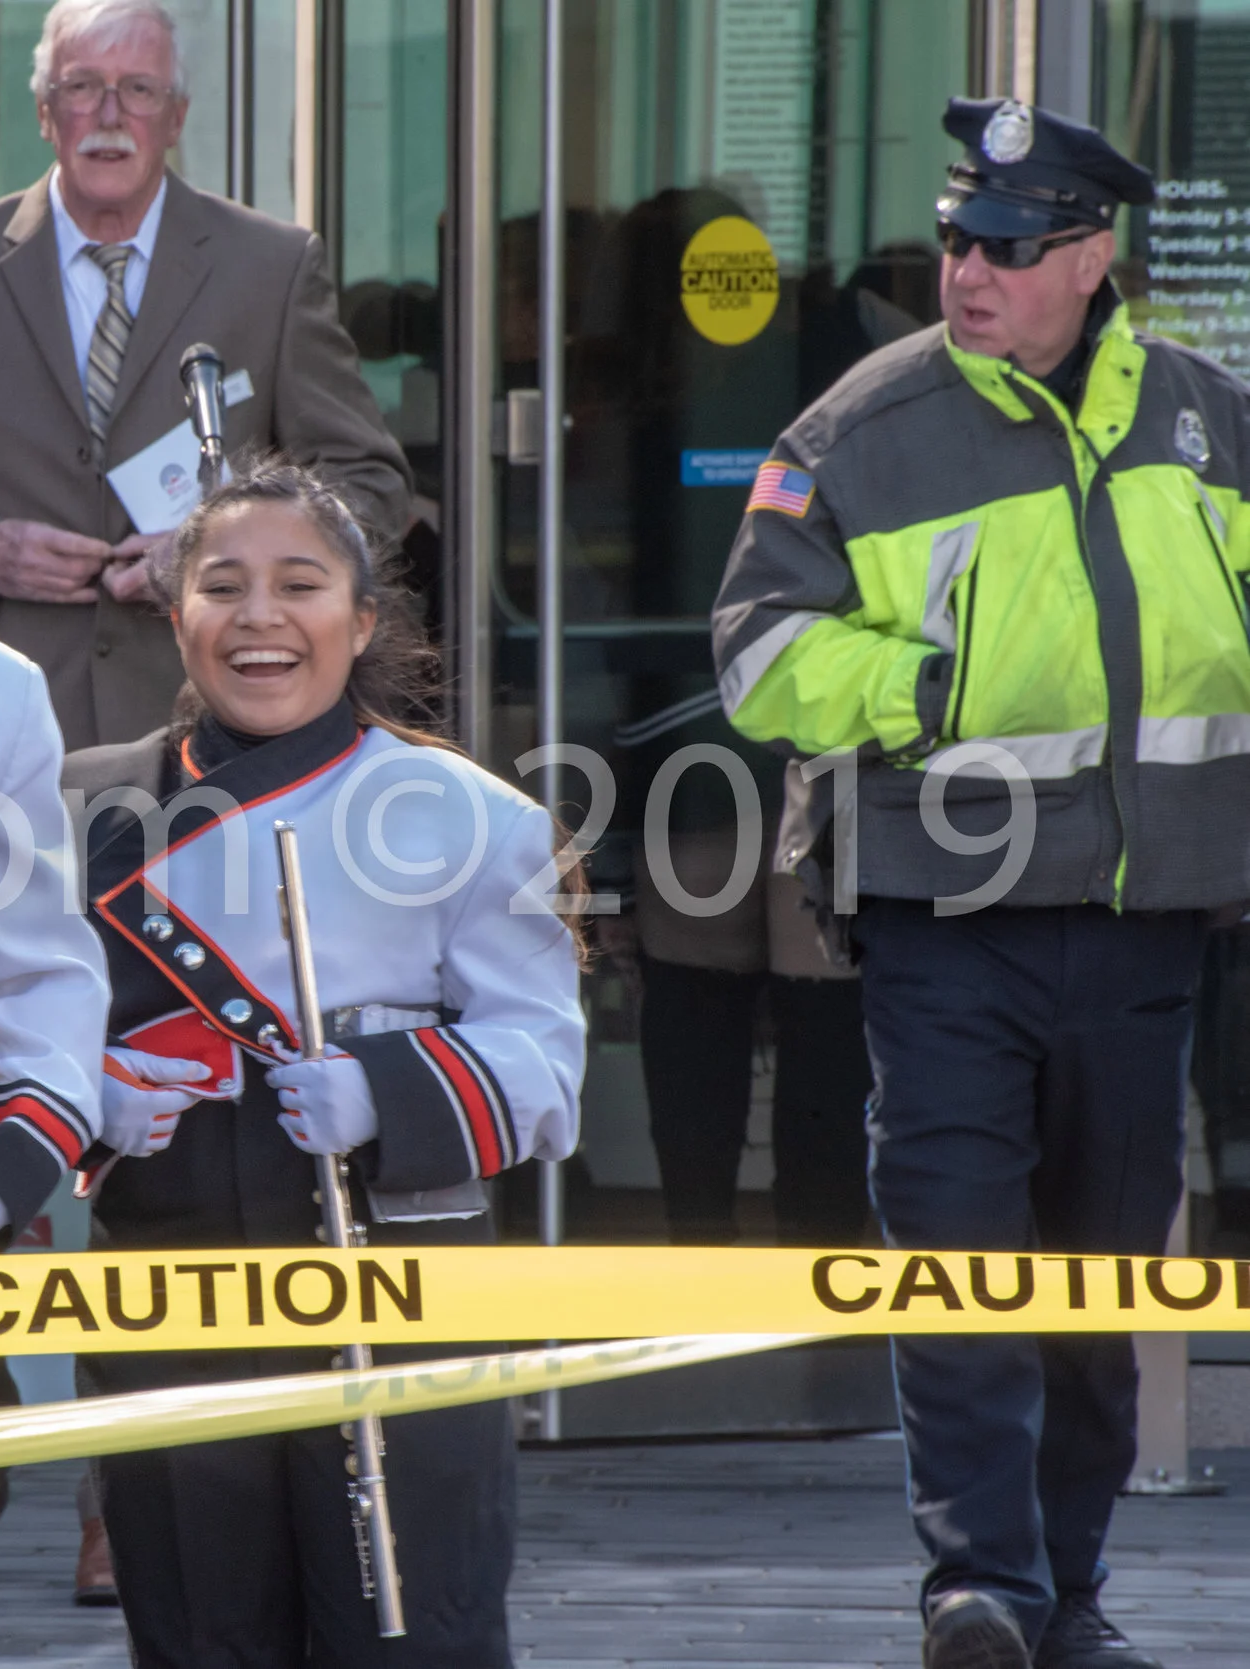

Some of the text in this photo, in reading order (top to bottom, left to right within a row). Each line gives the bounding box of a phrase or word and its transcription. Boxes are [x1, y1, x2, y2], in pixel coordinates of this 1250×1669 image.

[1149, 209, 1223, 229] Monday
[1148, 236, 1223, 255] Tuesday
[687, 251, 777, 270] AUTOMATIC
[681, 270, 778, 293] CAUTION
[1147, 262, 1250, 283] Wednesday
[709, 293, 752, 311] DOOR
[1147, 290, 1228, 309] Thursday
[1147, 317, 1201, 336] Friday
[812, 1254, 1250, 1314] CAUTIO
